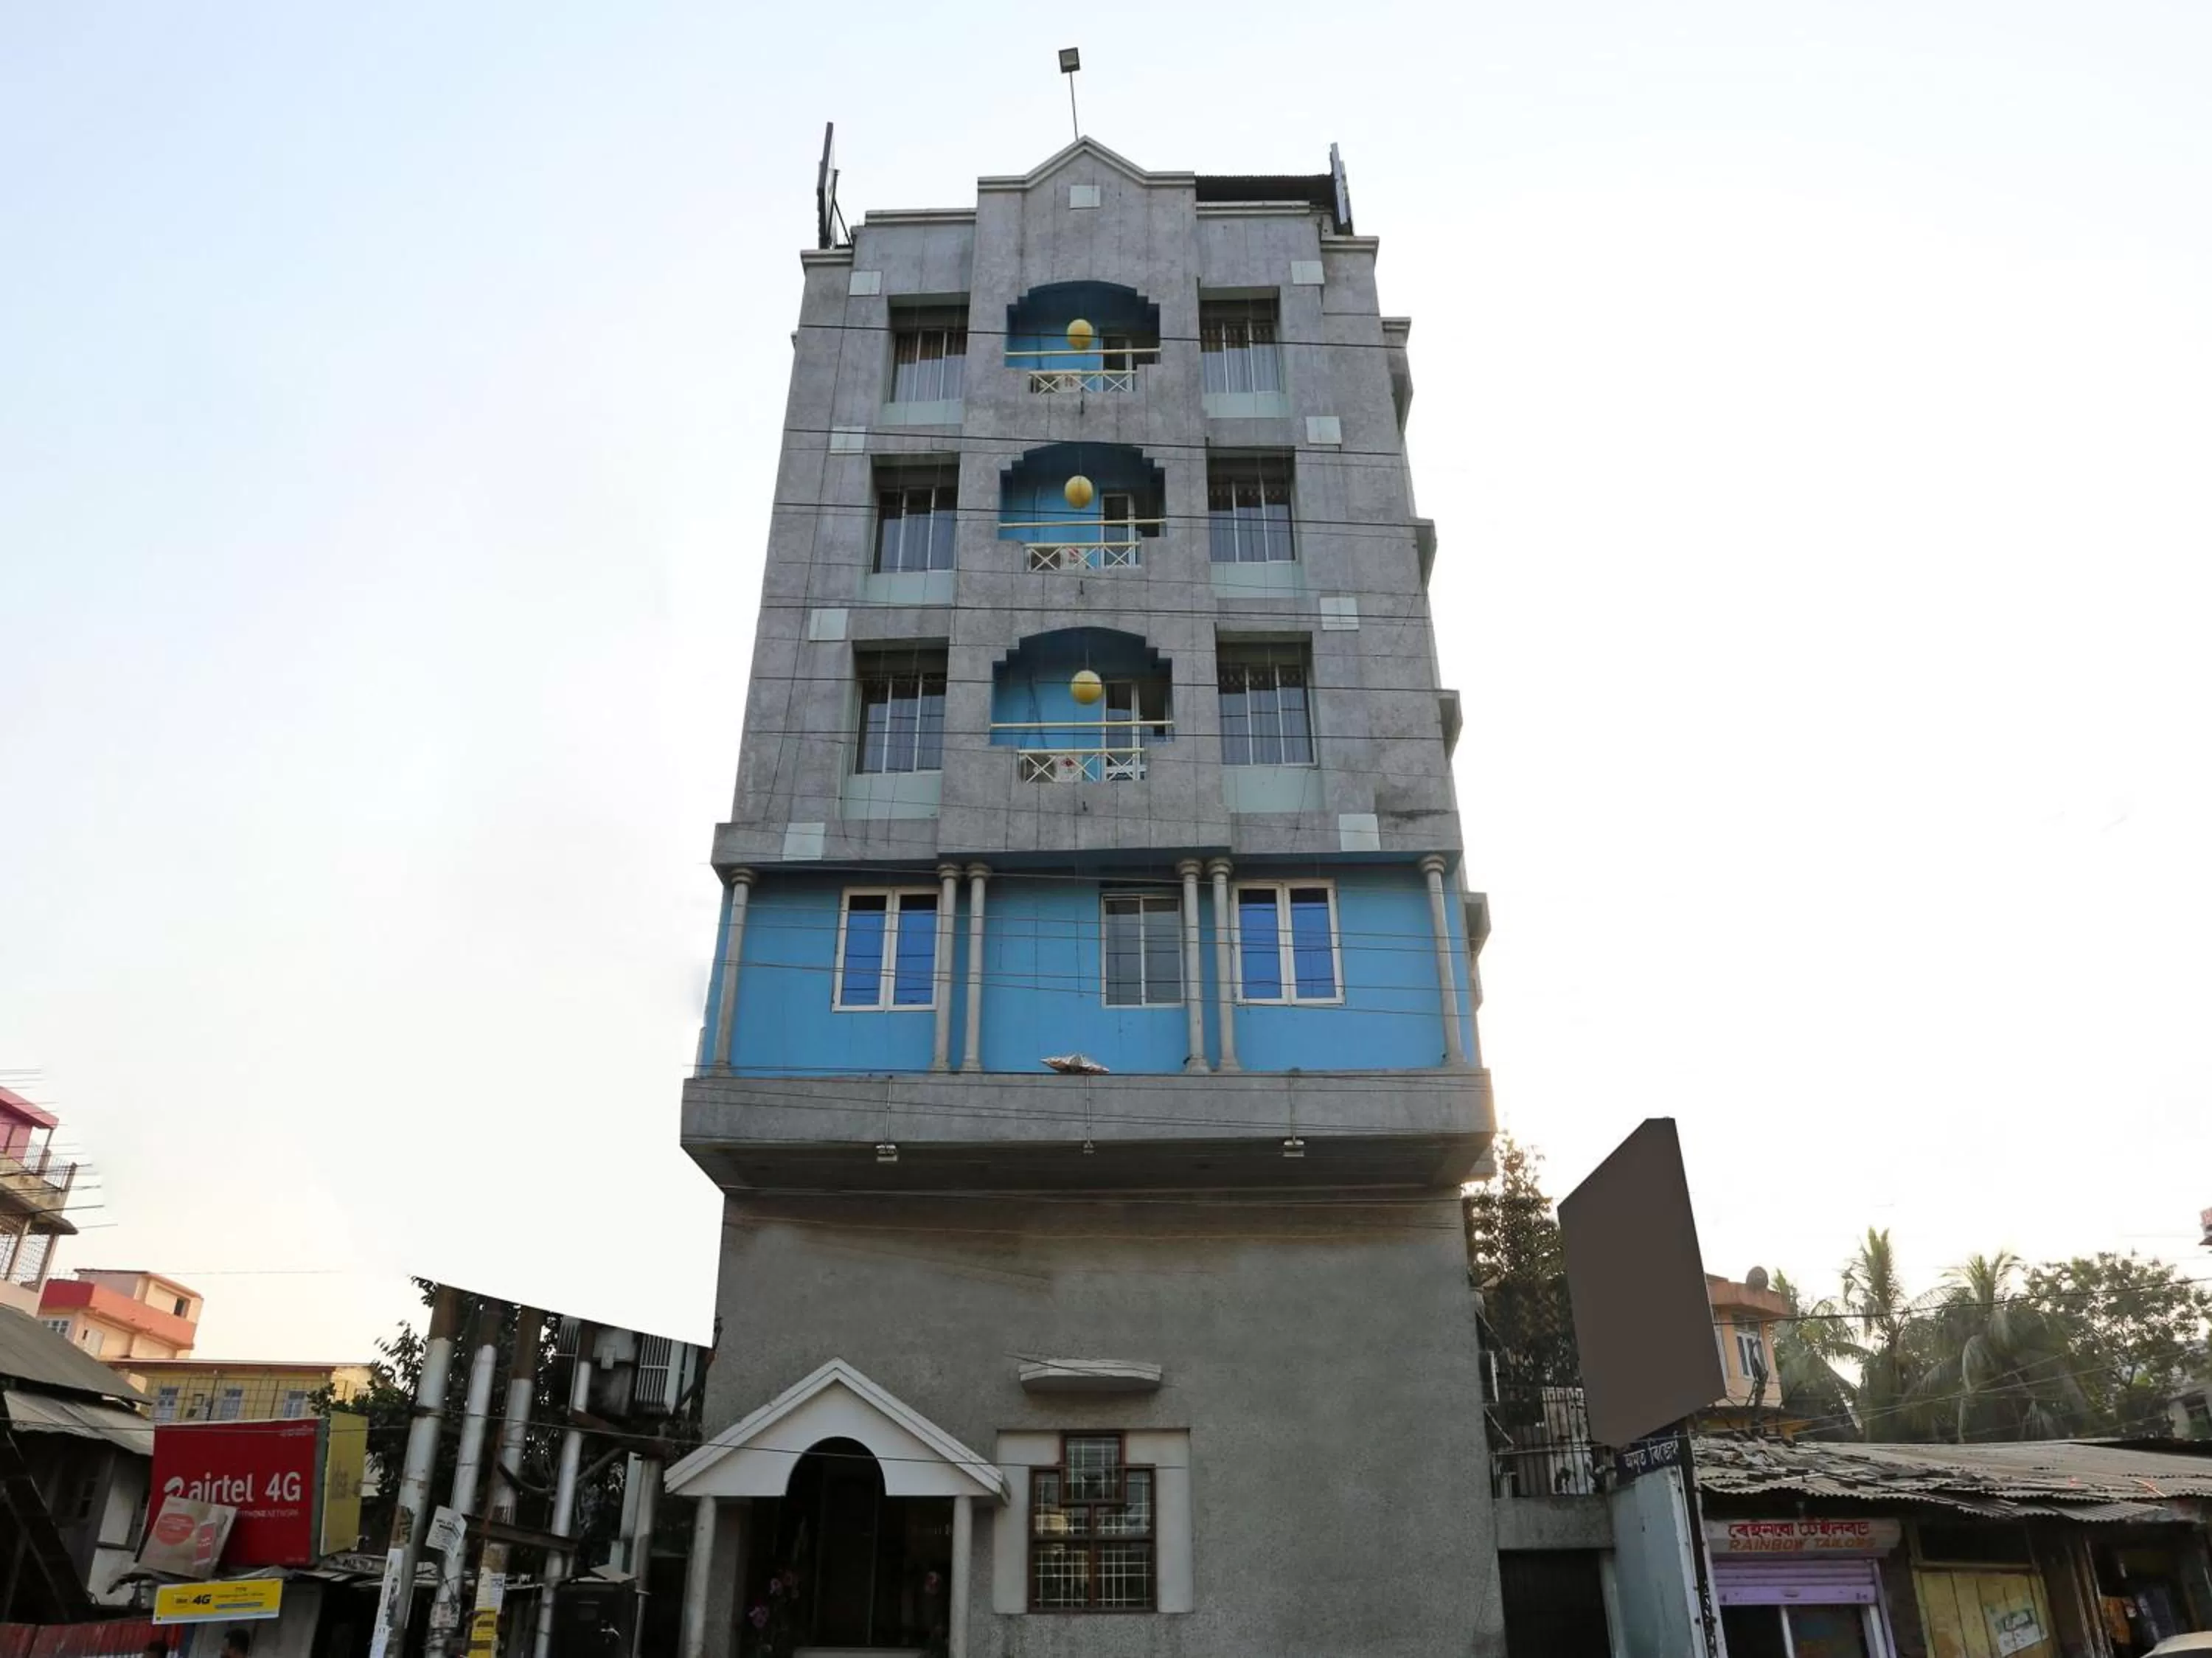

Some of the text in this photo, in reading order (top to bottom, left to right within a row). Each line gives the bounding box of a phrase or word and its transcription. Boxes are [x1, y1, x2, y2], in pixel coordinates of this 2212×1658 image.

[188, 1472, 254, 1503] airtel
[265, 1471, 301, 1502] 4G
[1729, 1538, 1806, 1552] RAINBOW
[192, 1595, 212, 1605] 4G
